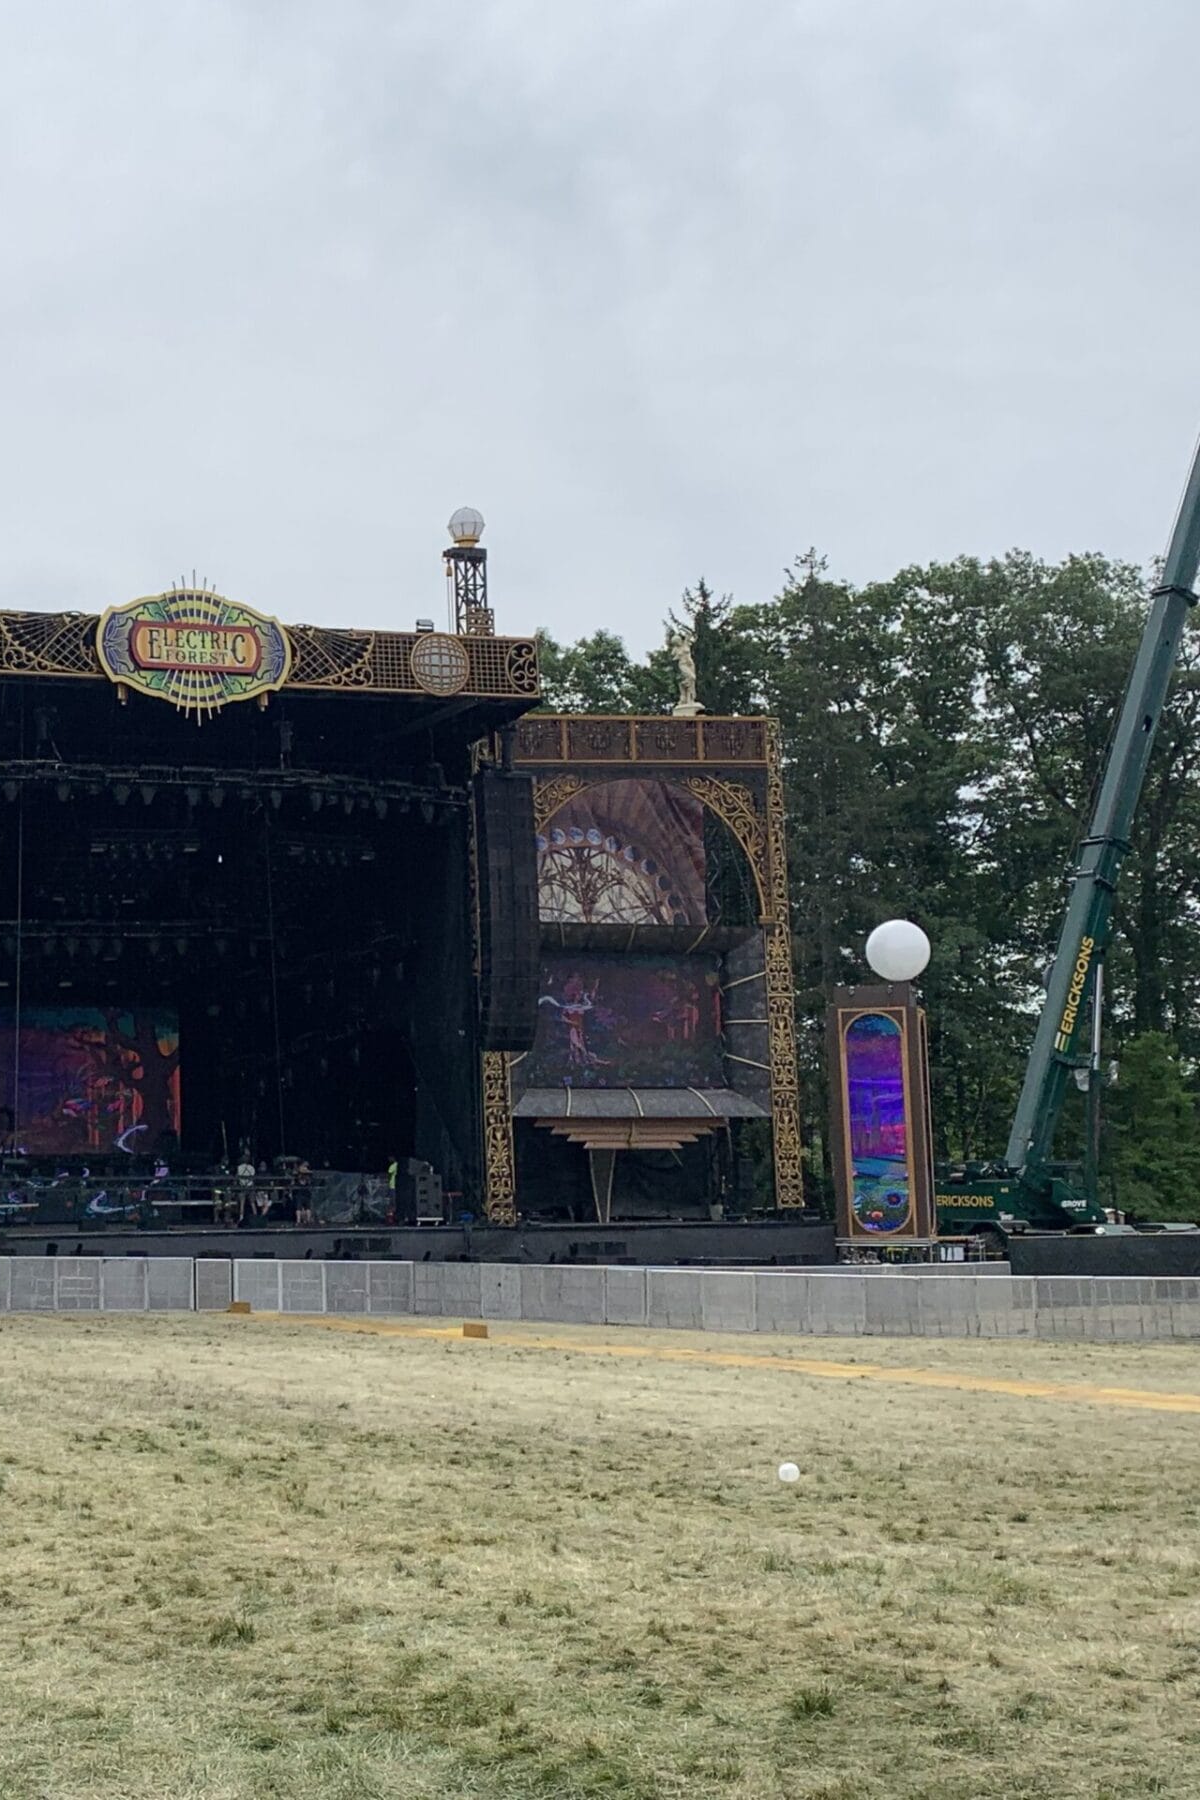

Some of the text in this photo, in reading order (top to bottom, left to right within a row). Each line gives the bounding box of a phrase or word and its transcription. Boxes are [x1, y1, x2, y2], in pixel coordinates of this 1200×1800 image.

[148, 629, 246, 664] ELECTRIC
[166, 650, 229, 665] FOREST
[1061, 936, 1095, 1034] ERICKSONS
[936, 1195, 994, 1207] ERICKSONS
